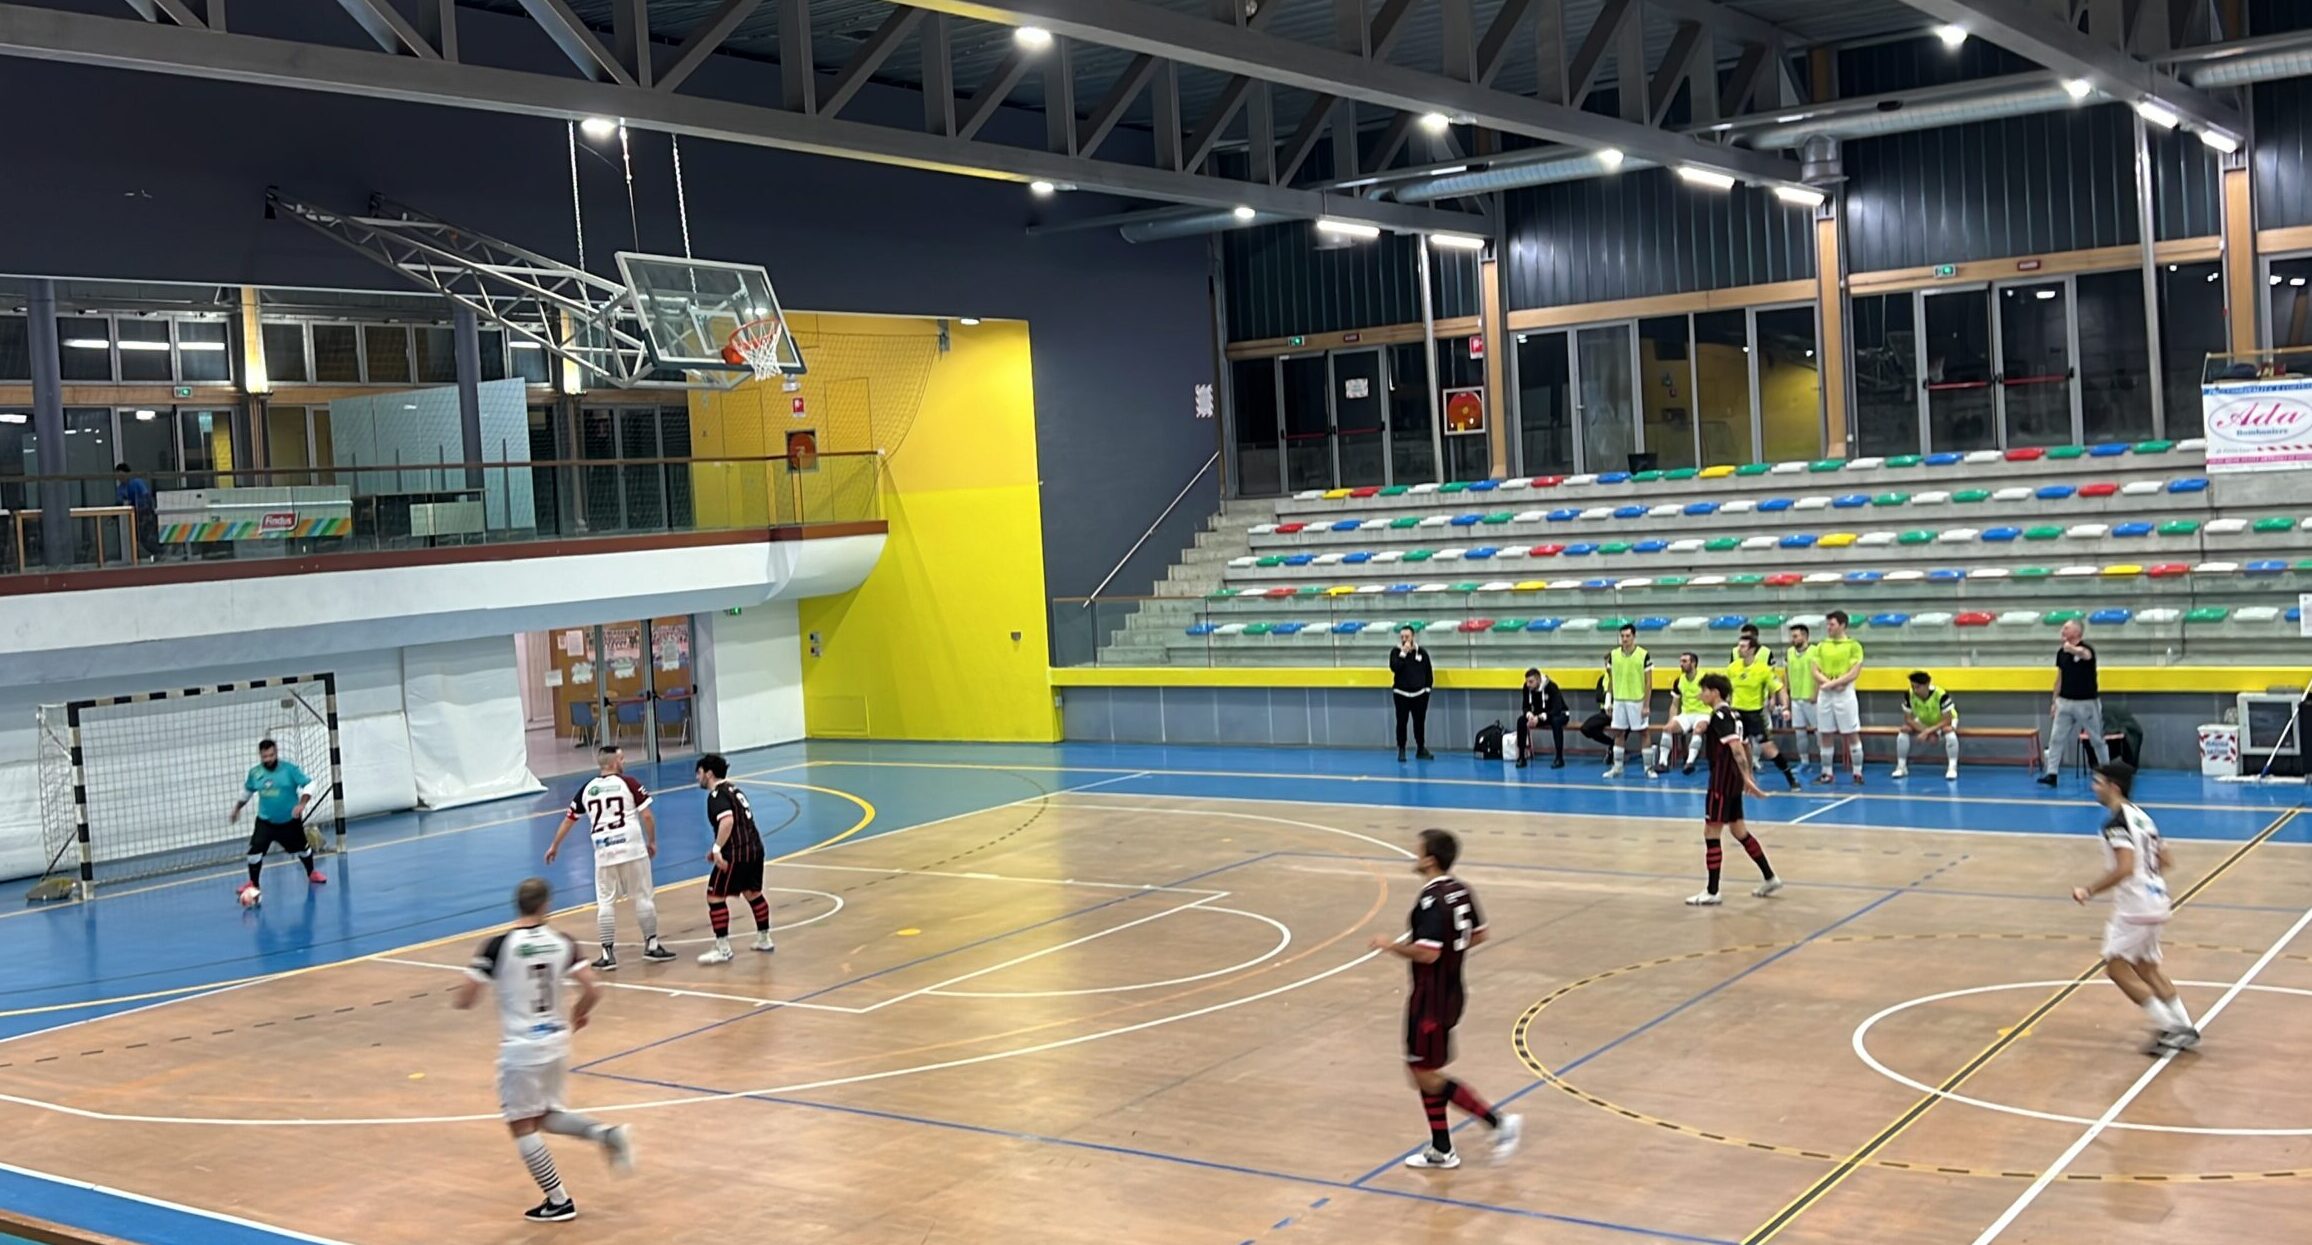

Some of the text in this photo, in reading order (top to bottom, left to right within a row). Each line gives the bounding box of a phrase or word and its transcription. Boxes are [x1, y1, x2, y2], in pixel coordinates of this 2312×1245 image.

[2217, 402, 2306, 427] Ada
[264, 515, 293, 526] Findus
[587, 796, 626, 834] 23
[736, 792, 751, 819] 9
[1453, 903, 1473, 951] 5
